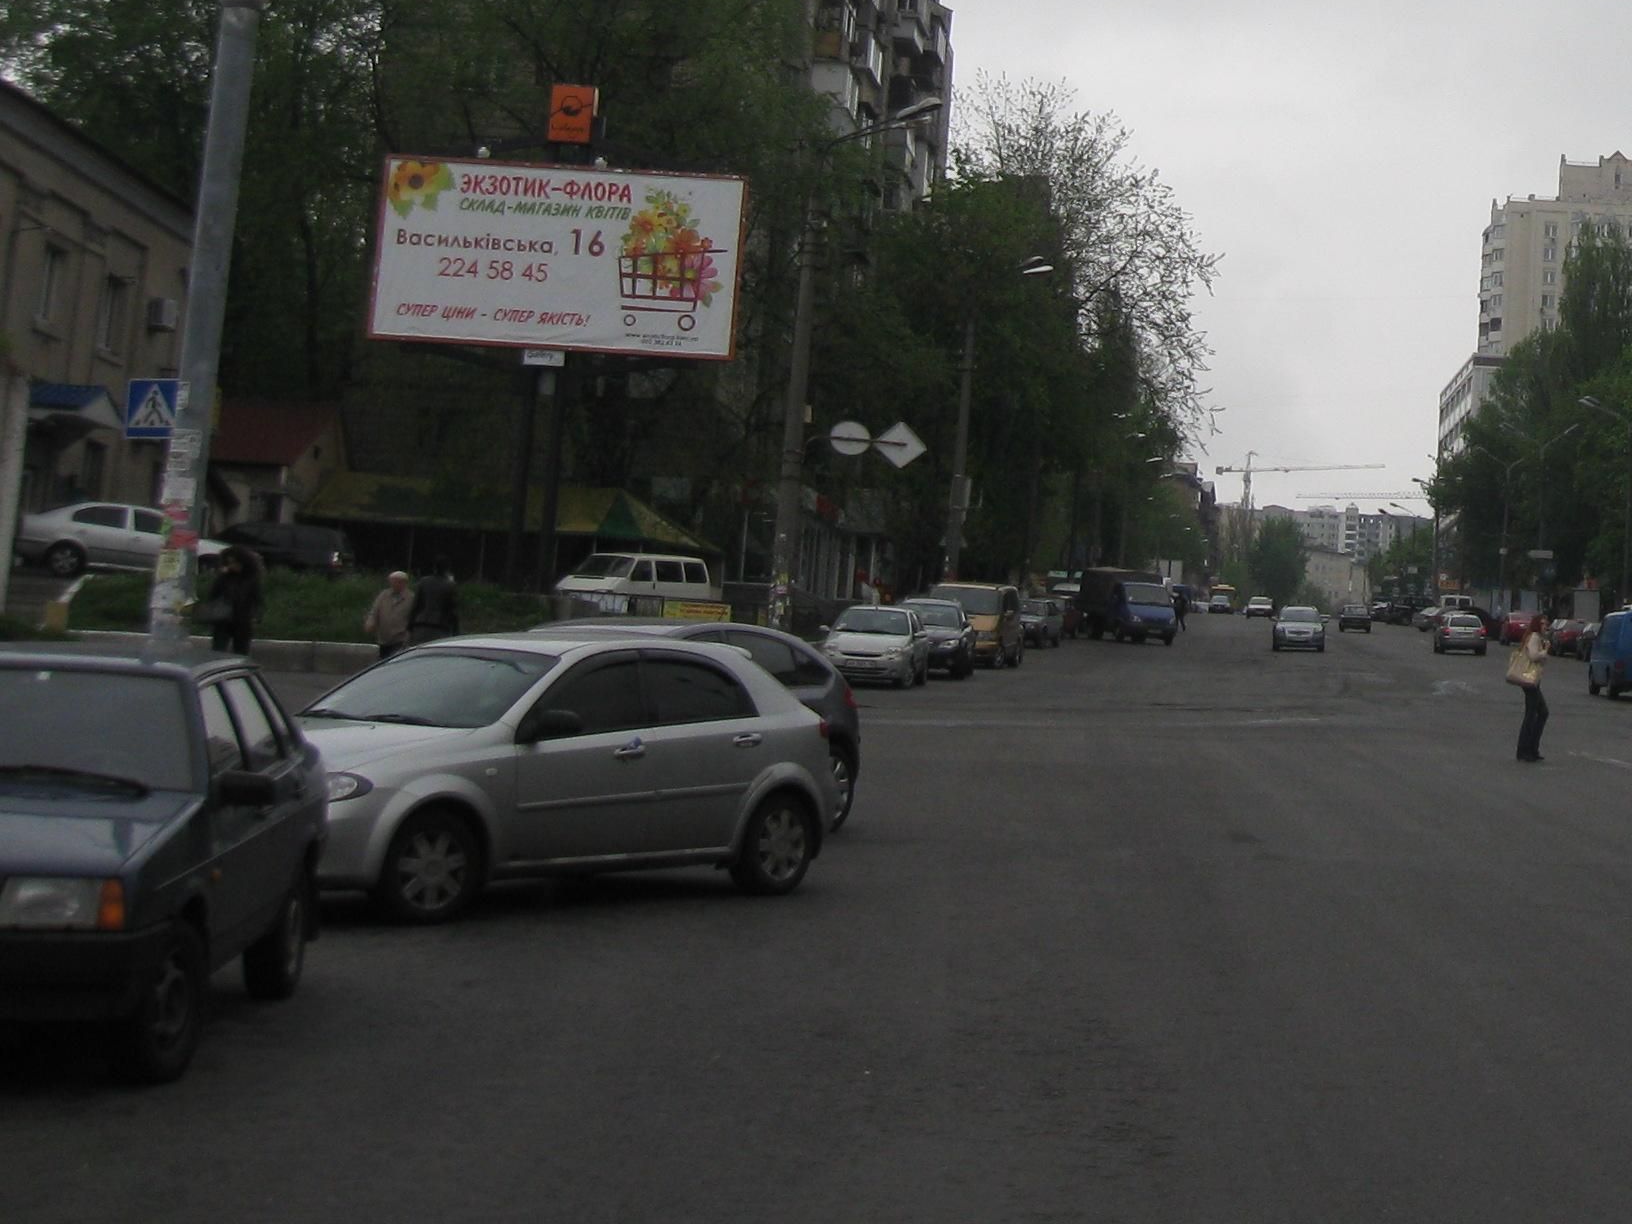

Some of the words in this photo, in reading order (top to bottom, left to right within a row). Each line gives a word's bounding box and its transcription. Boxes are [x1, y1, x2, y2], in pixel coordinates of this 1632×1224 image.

[460, 173, 632, 204] ЭКЗОТИК-ФЛОРА
[459, 197, 582, 218] СКЛАД-МАГАЗИН
[584, 205, 632, 221] КВІТІВ
[396, 228, 559, 256] Васильківська,
[570, 228, 605, 257] 16
[437, 256, 478, 278] 224
[486, 260, 514, 280] 58
[521, 263, 549, 283] 45
[396, 303, 438, 317] СУПЕР
[441, 306, 478, 320] ЦІНИ
[493, 309, 535, 323] СУПЕР
[537, 312, 591, 327] ЯКІСТЬ!
